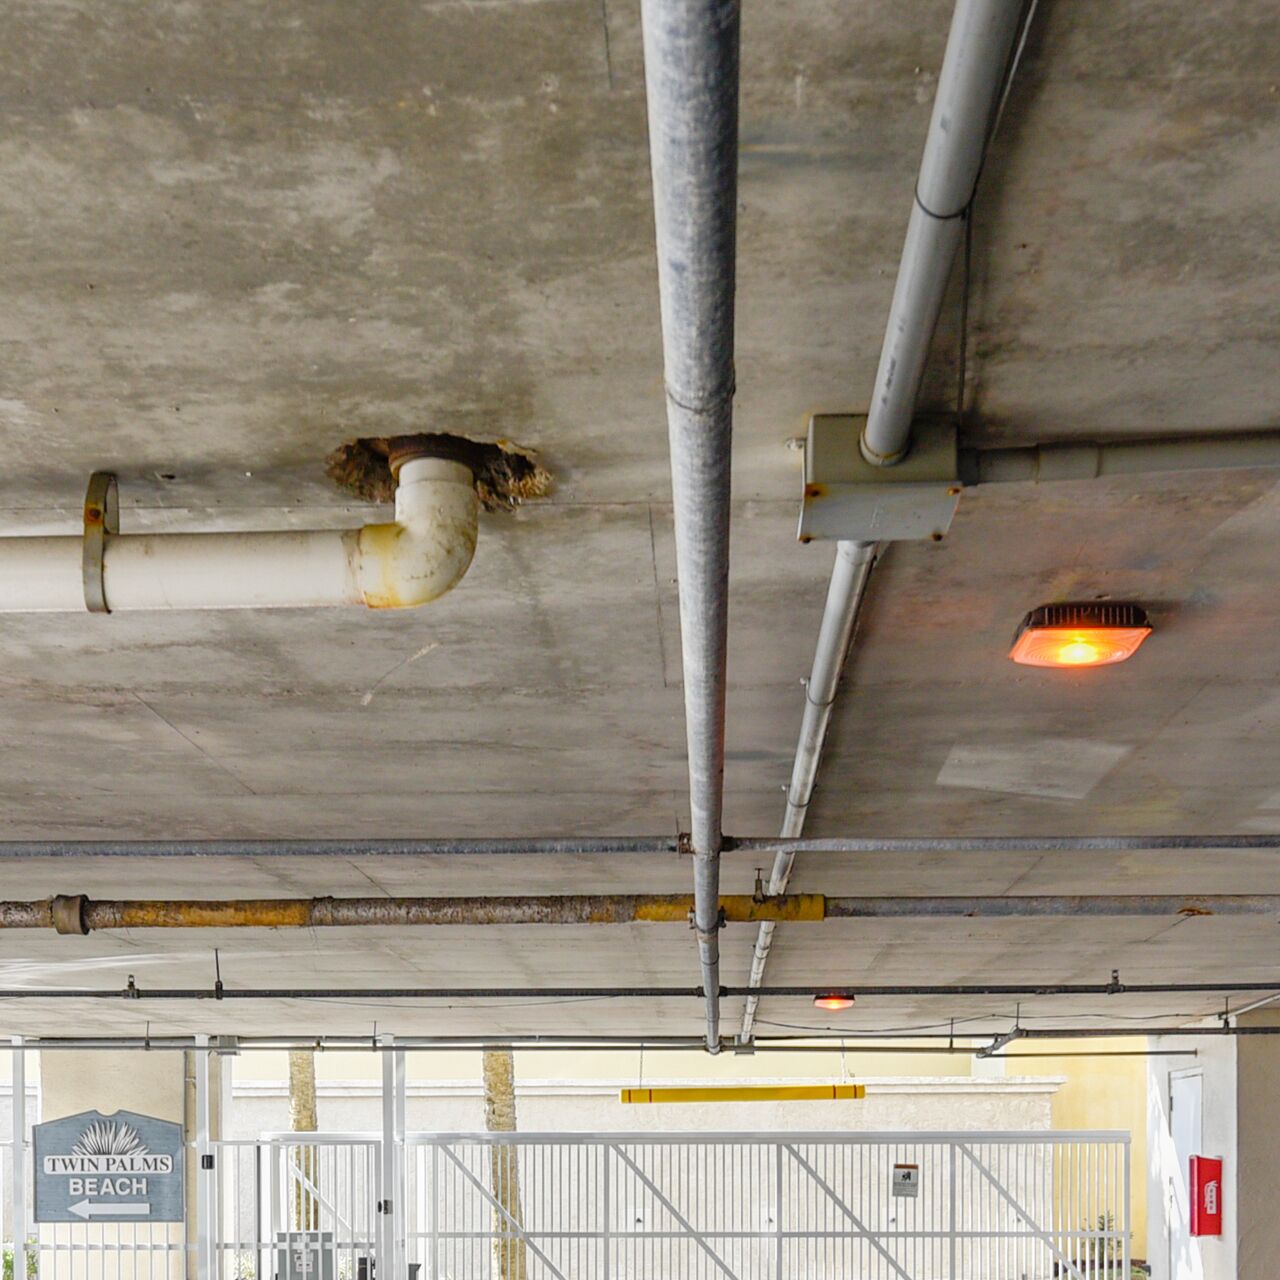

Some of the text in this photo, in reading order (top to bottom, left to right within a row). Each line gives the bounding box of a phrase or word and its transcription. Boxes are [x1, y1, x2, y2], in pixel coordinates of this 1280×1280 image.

[48, 1157, 170, 1172] TWIN PALMS
[69, 1178, 148, 1196] BEACH
